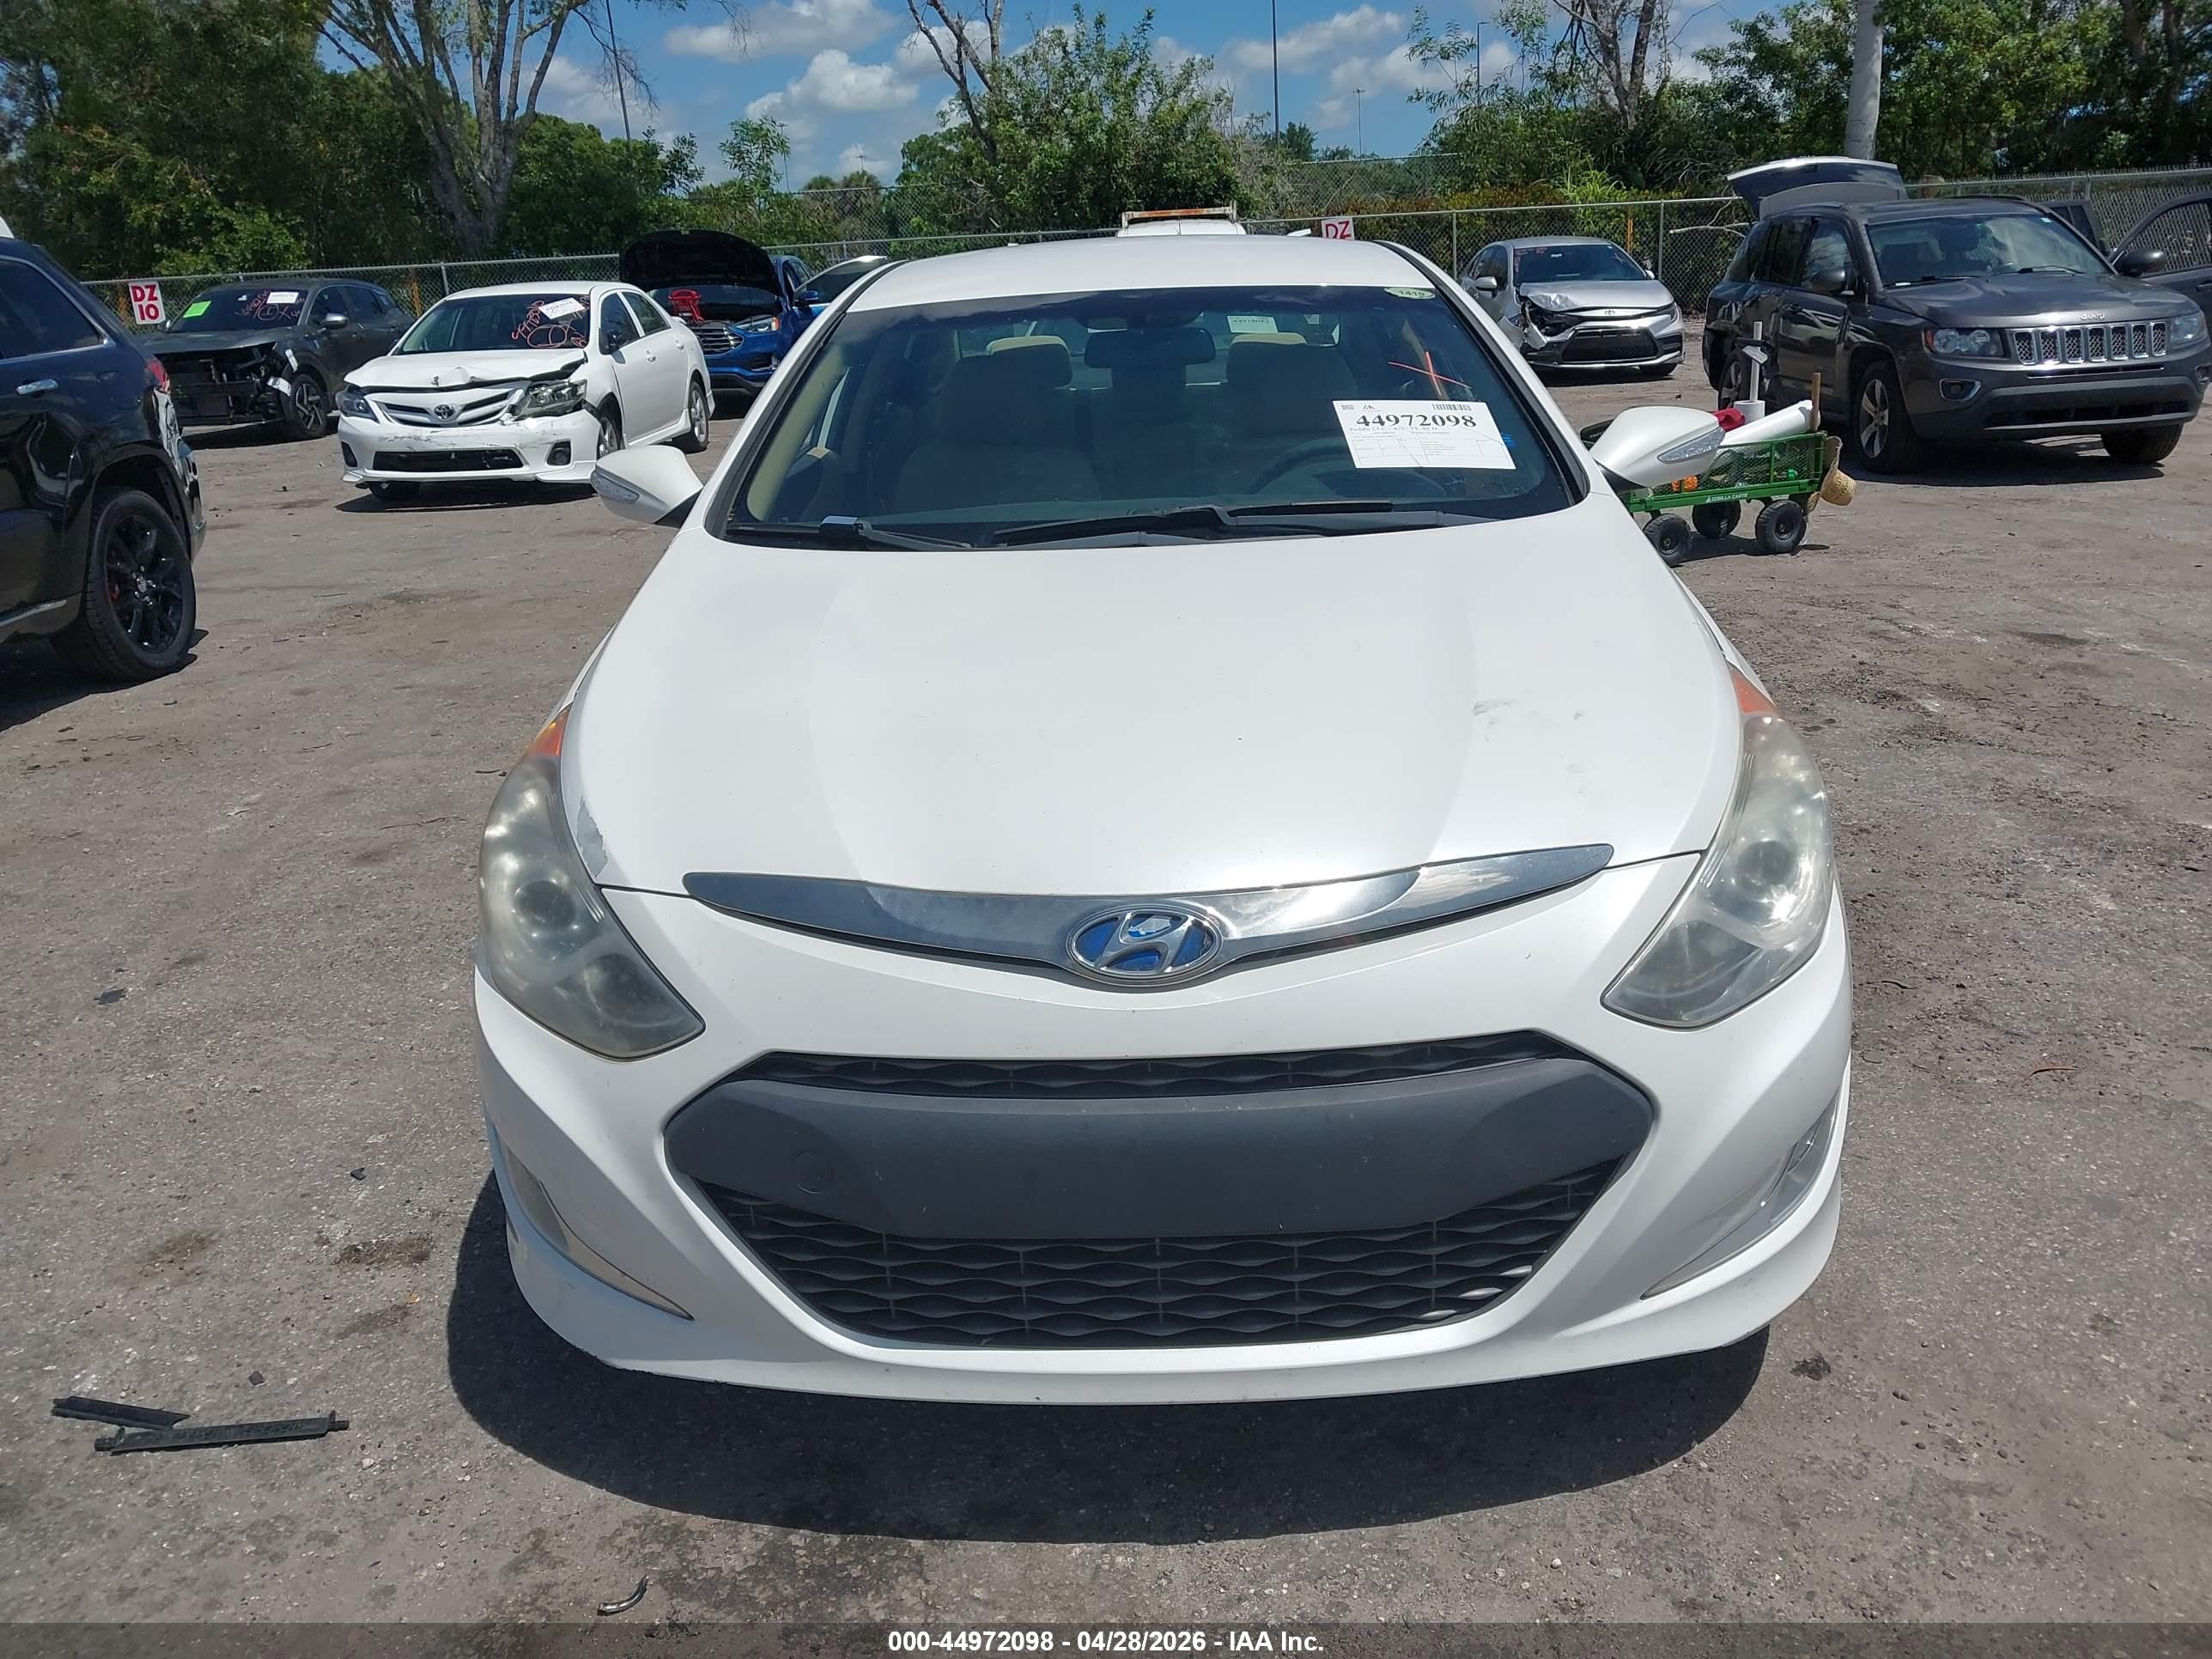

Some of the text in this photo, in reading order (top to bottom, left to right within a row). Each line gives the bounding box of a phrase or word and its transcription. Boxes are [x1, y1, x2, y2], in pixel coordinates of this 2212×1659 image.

[1325, 220, 1352, 240] DZ
[131, 284, 158, 302] DZ
[1356, 414, 1477, 428] 44972098
